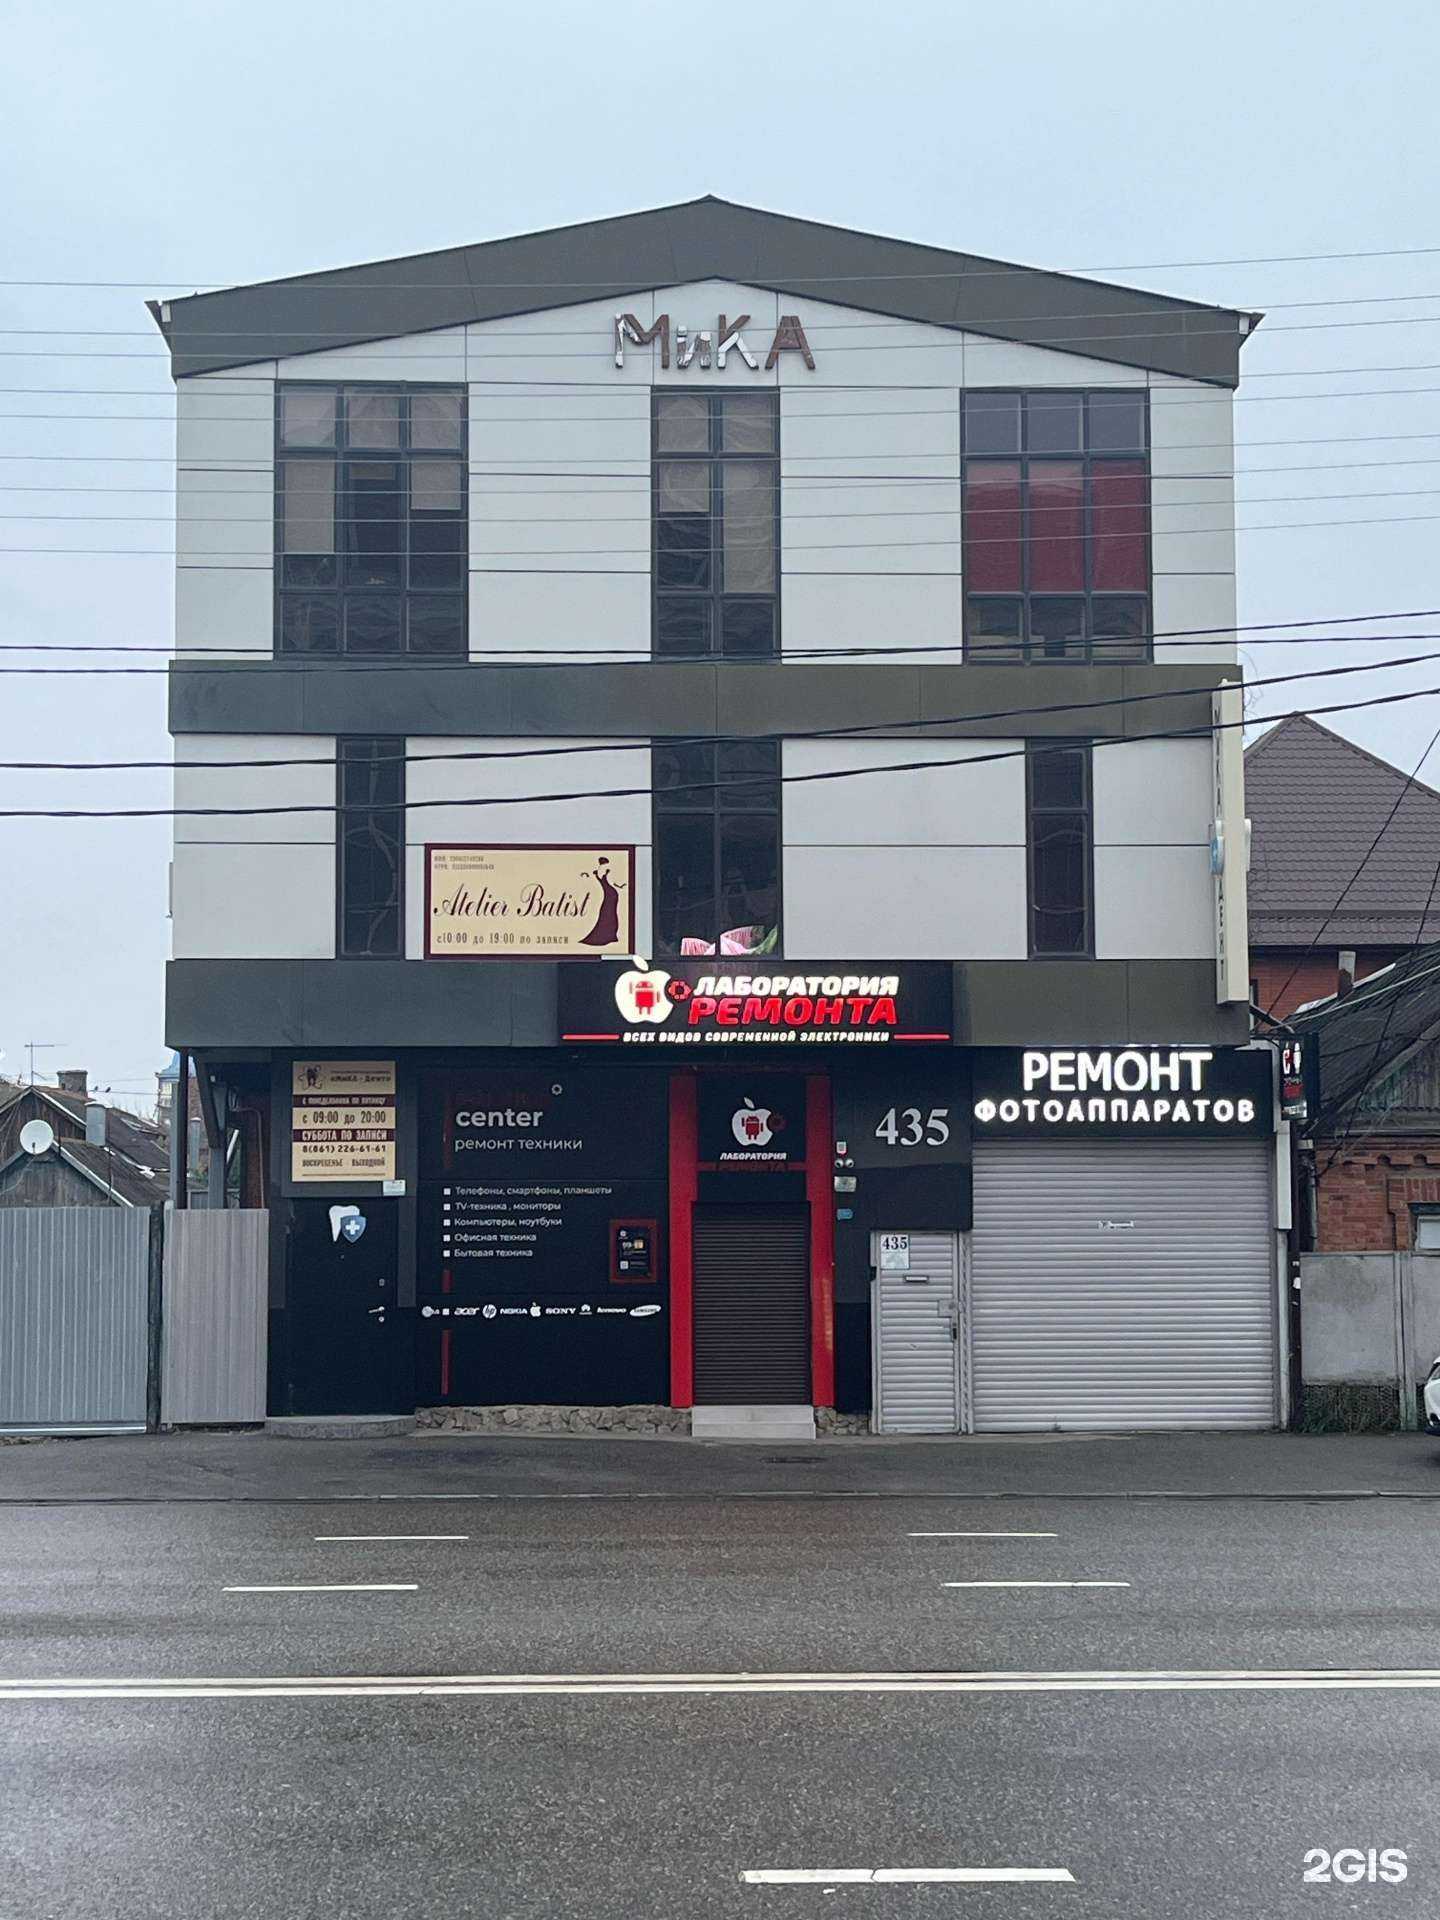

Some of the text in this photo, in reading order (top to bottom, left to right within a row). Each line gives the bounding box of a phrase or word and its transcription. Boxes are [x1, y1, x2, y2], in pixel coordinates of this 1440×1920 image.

[434, 883, 591, 917] Atelier Batist
[472, 935, 484, 945] до
[519, 935, 531, 944] по
[536, 935, 569, 944] записи
[693, 975, 900, 996] ЛАБОРАТОРИЯ
[687, 997, 898, 1025] РЕМОНТА
[623, 1030, 890, 1043] ВСЕХ ВИДОВ СОВРЕМЕННОЙ ЭЛЕКТРОНИКИ
[1022, 1051, 1213, 1092] РЕМОНТ
[974, 1098, 1256, 1123] ФОТОАППАРАТОВ
[313, 1111, 339, 1123] 09:00
[344, 1114, 355, 1125] до
[360, 1111, 386, 1123] 20:00
[455, 1108, 543, 1127] center
[875, 1107, 950, 1146] 435
[302, 1130, 388, 1141] СУББОТА ПО ЗАПИСИ
[454, 1138, 583, 1152] ремонт техники
[720, 1152, 787, 1160] ЛАБОРАТОРИЯ
[455, 1186, 505, 1196] Телефоны,
[564, 1186, 612, 1194] планшеты
[513, 1202, 561, 1211] мониторы
[519, 1217, 562, 1226] ноутбуки
[454, 1233, 536, 1242] Офисная техника
[882, 1236, 908, 1250] 435
[454, 1248, 533, 1257] Бытовая техника
[453, 1307, 480, 1315] acer
[545, 1307, 576, 1315] SONY
